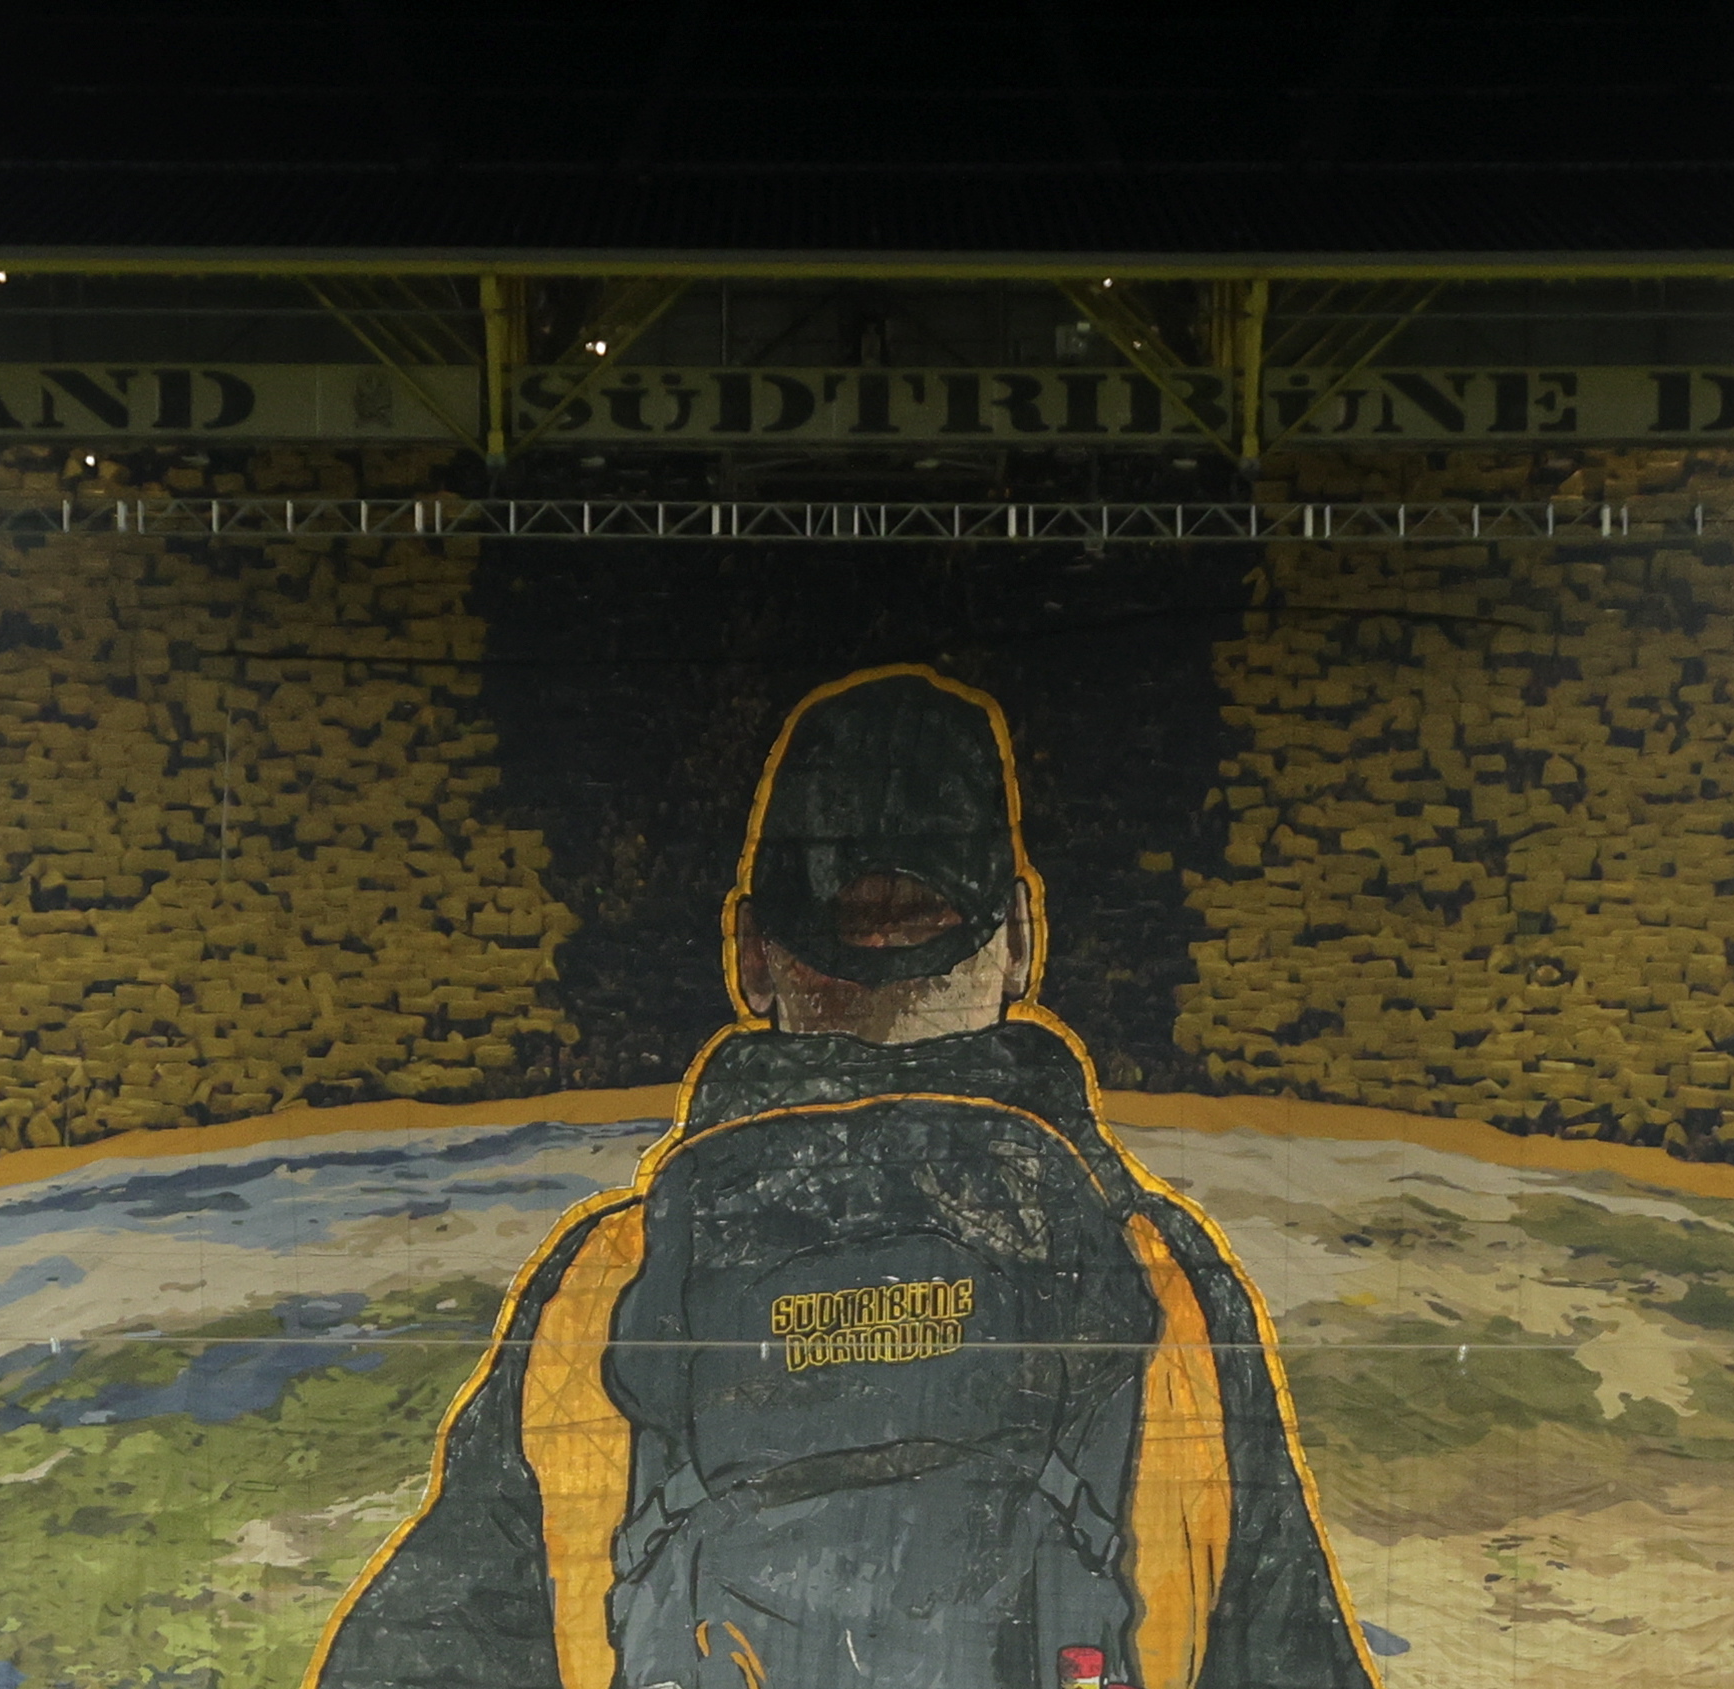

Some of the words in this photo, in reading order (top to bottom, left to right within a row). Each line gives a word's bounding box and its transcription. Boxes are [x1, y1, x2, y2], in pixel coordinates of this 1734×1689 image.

[517, 369, 1577, 436] SÜDTRIBÜNE
[771, 1278, 974, 1334] SÜDTRIBÜNE
[786, 1318, 964, 1373] DORTMUND
